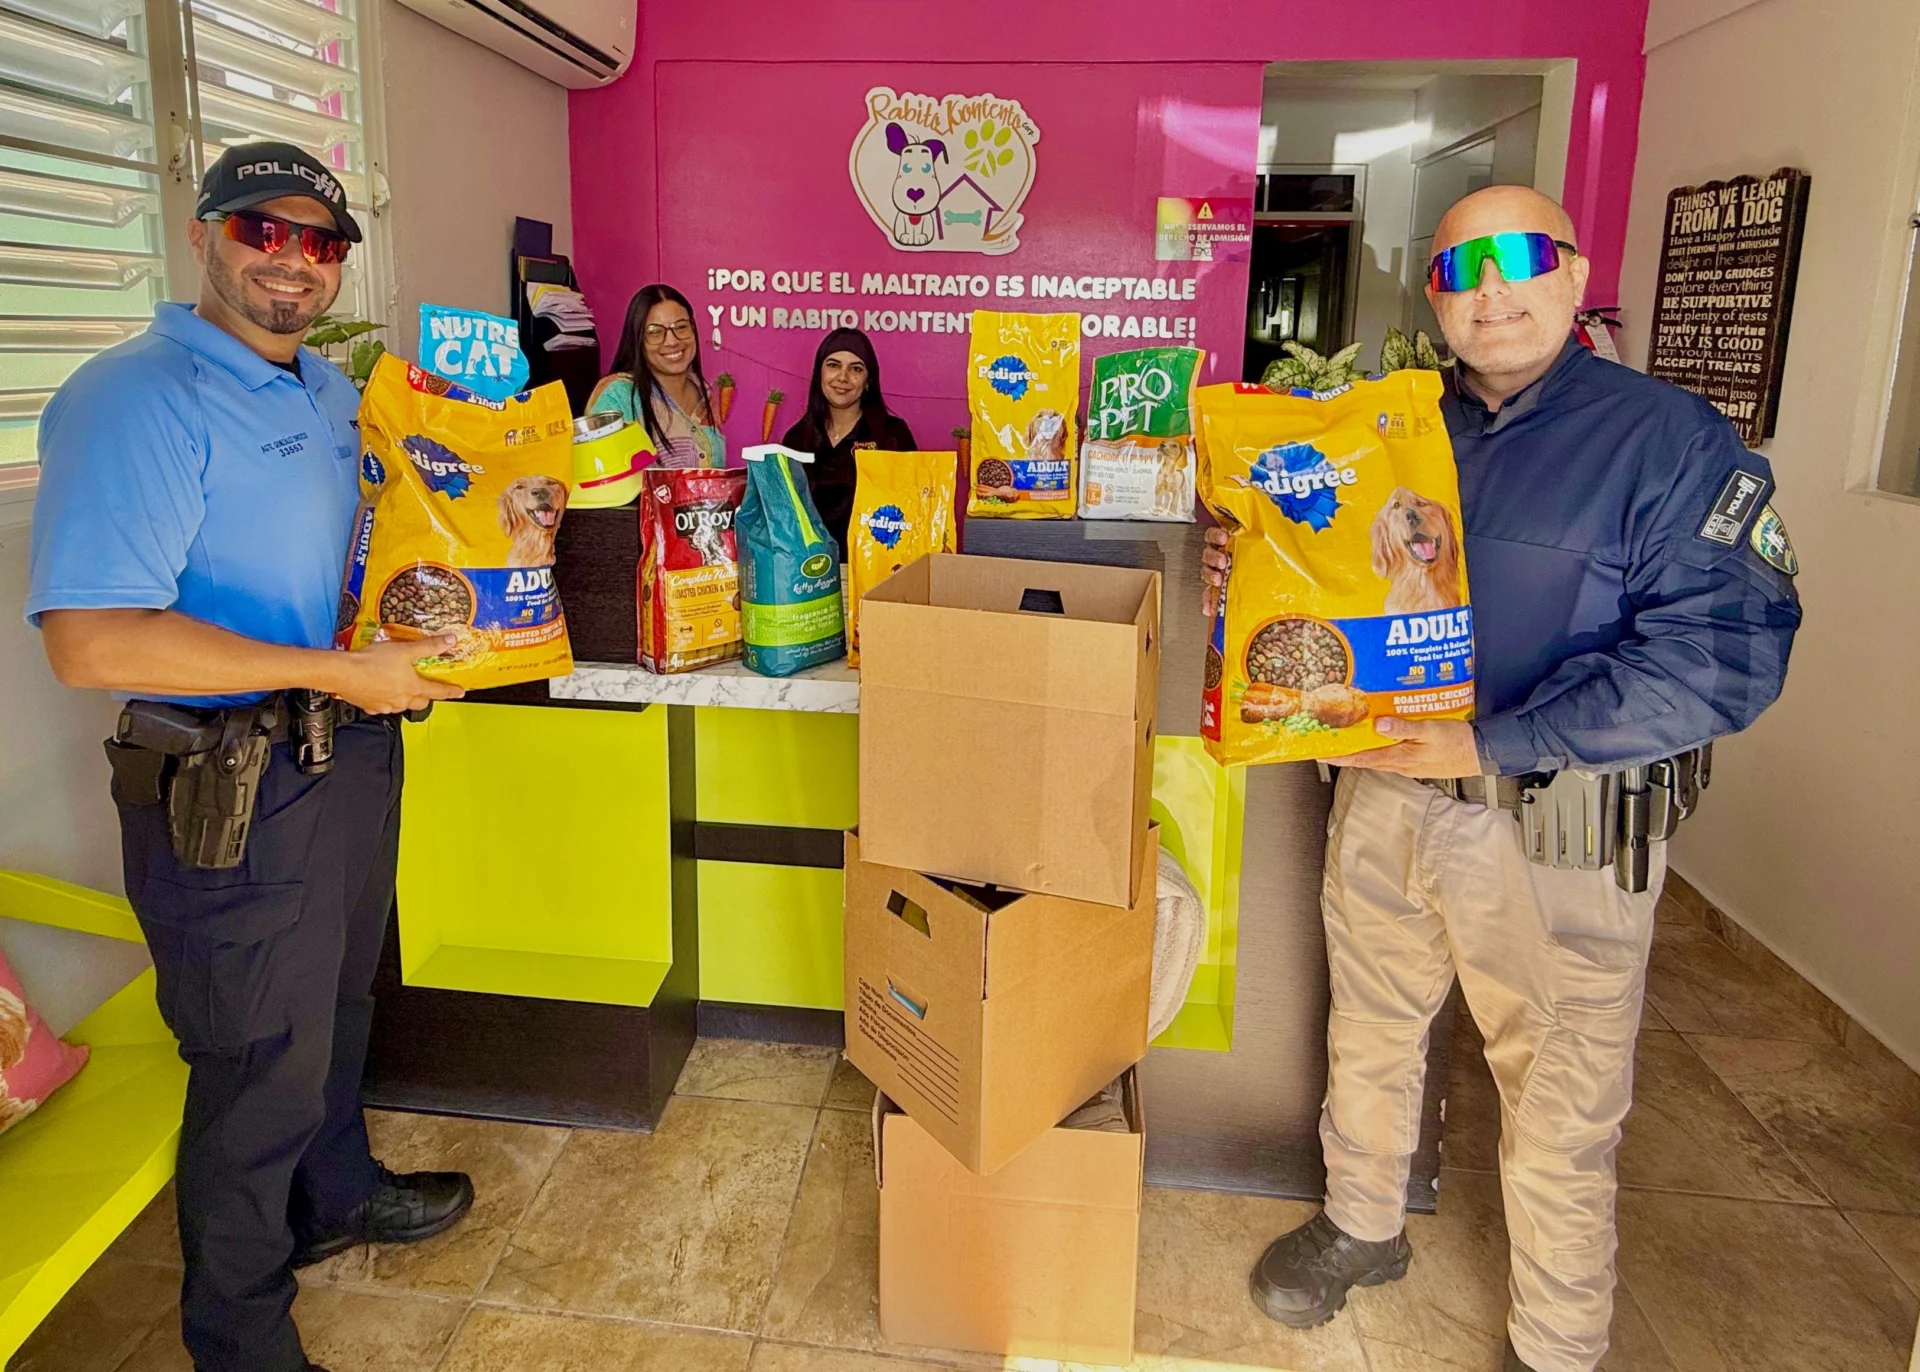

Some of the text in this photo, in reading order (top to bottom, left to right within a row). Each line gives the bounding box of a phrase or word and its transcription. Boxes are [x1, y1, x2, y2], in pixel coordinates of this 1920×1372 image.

[870, 93, 941, 131] Rabito
[1674, 178, 1787, 213] THINGS WE LEARN
[1670, 197, 1784, 236] FROM A DOG
[1182, 223, 1236, 231] RESERVAMOS
[1237, 223, 1246, 231] EL
[1670, 224, 1782, 246] Have a Happy Attitude
[1159, 232, 1250, 242] DERECHO DE ADMISIÓN
[1668, 238, 1780, 257] GREET EVERYONE WITH ENTHUSIASM
[1702, 257, 1712, 266] in
[1738, 249, 1777, 268] simple
[1665, 266, 1775, 282] DON'T HOLD GRUDGES
[771, 270, 824, 295] QUE
[828, 271, 856, 295] EL
[860, 272, 990, 298] MALTRATO
[995, 274, 1025, 298] ES
[1031, 274, 1197, 301] INACEPTABLE
[1663, 279, 1773, 295] explore everything
[1662, 294, 1773, 309] BE SUPPORTIVE
[707, 304, 725, 327] Y
[730, 305, 767, 328] UN
[772, 306, 859, 331] RABITO
[1080, 314, 1197, 339] ORABLE!
[1660, 308, 1768, 324] take plenty of rests
[430, 315, 520, 349] NUTRE
[1659, 323, 1766, 337] loyalty is a virtue
[1657, 335, 1764, 351] PLAY IS GOOD
[434, 340, 518, 378] CAT
[1656, 348, 1763, 361] SET YOUR LIMITS
[1654, 357, 1762, 374] ACCEPT TREATS
[977, 364, 1039, 385] Pedigree
[1653, 370, 1758, 385] protect those you love
[1100, 367, 1173, 409] PRO
[1312, 383, 1351, 402] ADULT
[1707, 385, 1728, 398] with
[1730, 390, 1758, 401] gusto
[467, 393, 506, 411] ADULT
[1099, 401, 1159, 439] PET
[1391, 420, 1405, 428] USA
[1026, 460, 1069, 473] ADULT
[859, 512, 913, 534] Pedigree
[356, 510, 373, 566] ADULT
[671, 573, 713, 587] Complete
[672, 580, 737, 600] ROASTED CHICKEN & RICE
[521, 608, 534, 617] NO
[504, 630, 540, 641] ROASTED
[1385, 609, 1470, 646] ADULT
[505, 635, 548, 648] VEGETABLE
[1386, 648, 1409, 657] 100%
[1409, 644, 1442, 655] Complete
[1442, 642, 1449, 650] &
[1414, 654, 1432, 663] Food
[1432, 652, 1443, 661] for
[1444, 649, 1461, 658] Adult
[1409, 665, 1425, 676] NO
[1439, 661, 1454, 672] NO
[1393, 692, 1438, 705] ROASTED
[1203, 701, 1215, 728] 14
[1395, 701, 1452, 714] VEGETABLE
[859, 976, 870, 991] Caja
